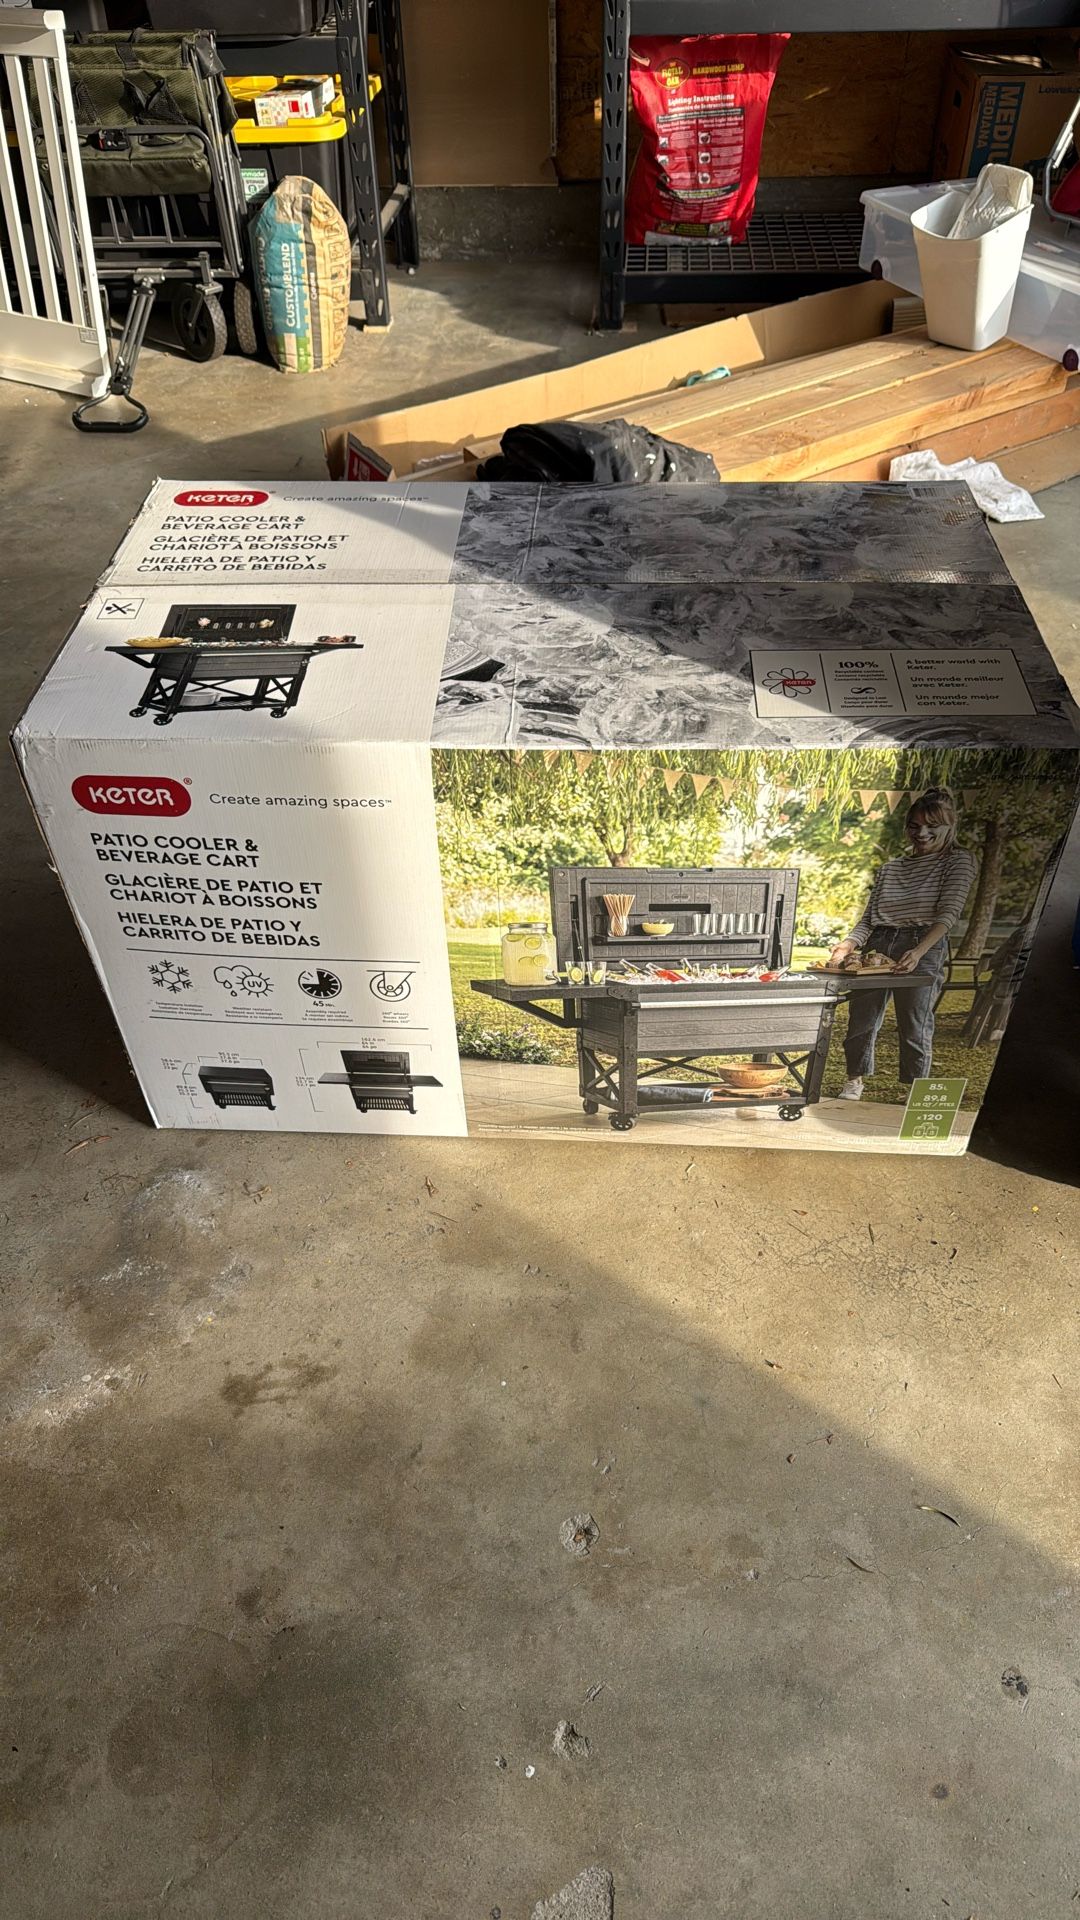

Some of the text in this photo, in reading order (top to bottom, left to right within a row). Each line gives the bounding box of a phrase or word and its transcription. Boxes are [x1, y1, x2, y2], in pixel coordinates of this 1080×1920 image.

[693, 94, 735, 103] Instructions
[978, 85, 999, 149] MEDIANA
[328, 495, 378, 503] amazing
[165, 515, 306, 523] PATIO COOLER &
[154, 533, 350, 543] GLACIÈRE DE PATIO ET
[149, 543, 231, 551] CHARIOT
[141, 556, 215, 564] HIELERA
[220, 555, 244, 563] DE
[136, 564, 217, 572] CARRITO
[251, 563, 328, 571] BEBIDAS
[838, 661, 879, 669] 100%
[970, 693, 1000, 701] mejor
[209, 793, 261, 806] Create
[265, 795, 328, 809] amazing
[90, 832, 259, 852] PATIO COOLER &
[95, 848, 260, 868] BEVERAGE CART
[104, 872, 323, 895] GLACIÈRE DE PATIO ET
[109, 888, 318, 910] CHARIOT À BOISSONS
[117, 911, 302, 932] HIELERA DE PATIO Y
[122, 926, 321, 947] CARRITO DE BEBIDAS
[247, 980, 263, 988] UV
